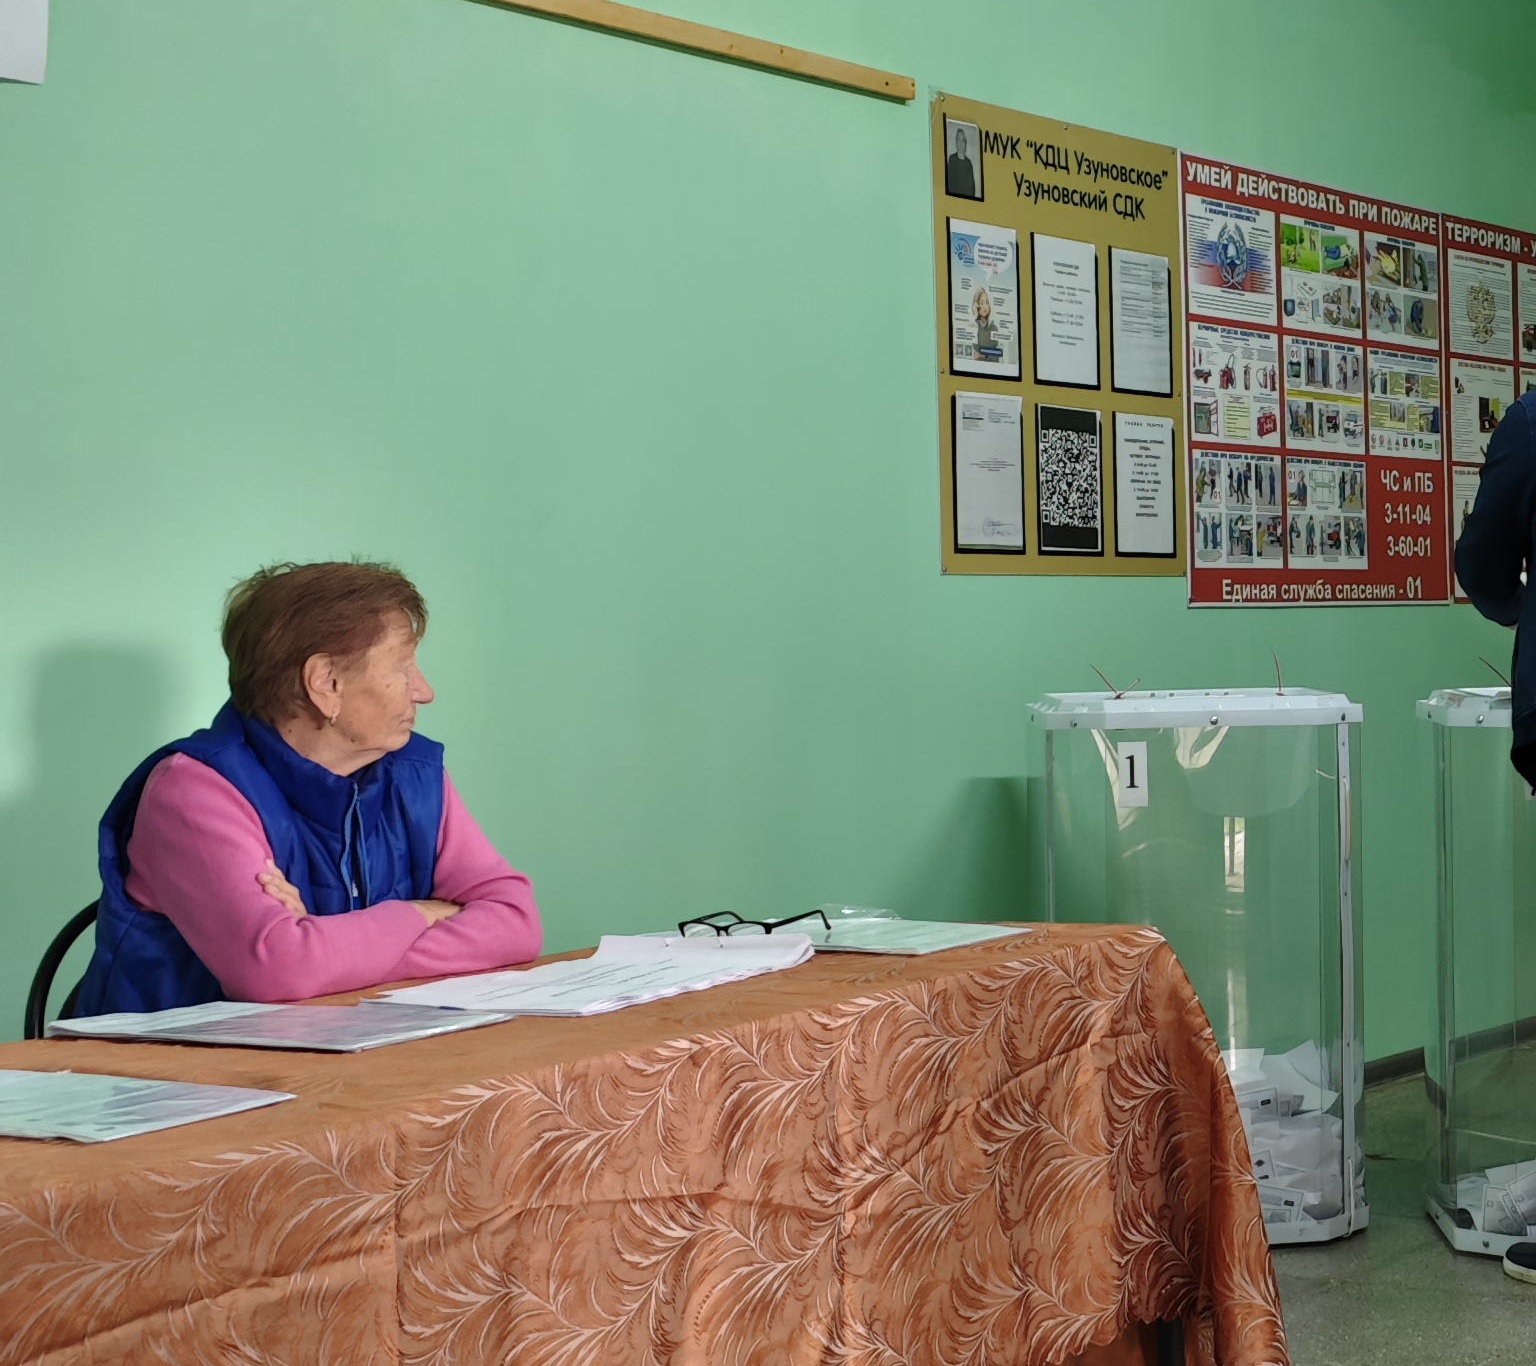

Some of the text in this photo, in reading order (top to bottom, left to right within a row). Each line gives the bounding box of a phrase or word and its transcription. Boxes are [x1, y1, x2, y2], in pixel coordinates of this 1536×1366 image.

[984, 130, 1022, 161] МУК
[1013, 171, 1146, 221] Узуновский СДК
[1186, 160, 1232, 190] УМЕЙ
[1236, 173, 1346, 216] ДЕЙСТВОВАТЬ
[1349, 199, 1378, 223] ПРИ
[1381, 207, 1438, 236] ПОЖАРЕ
[1445, 221, 1521, 255] ТЕРРОРИЗМ
[1380, 469, 1434, 493] ЧС и ПБ
[1384, 502, 1432, 525] 3-11-04
[1386, 535, 1431, 557] 3-60-01
[1222, 579, 1277, 603] Единая
[1281, 579, 1332, 603] служба
[1336, 583, 1396, 599] спасения
[1406, 576, 1422, 599] 01
[1125, 754, 1139, 789] 1
